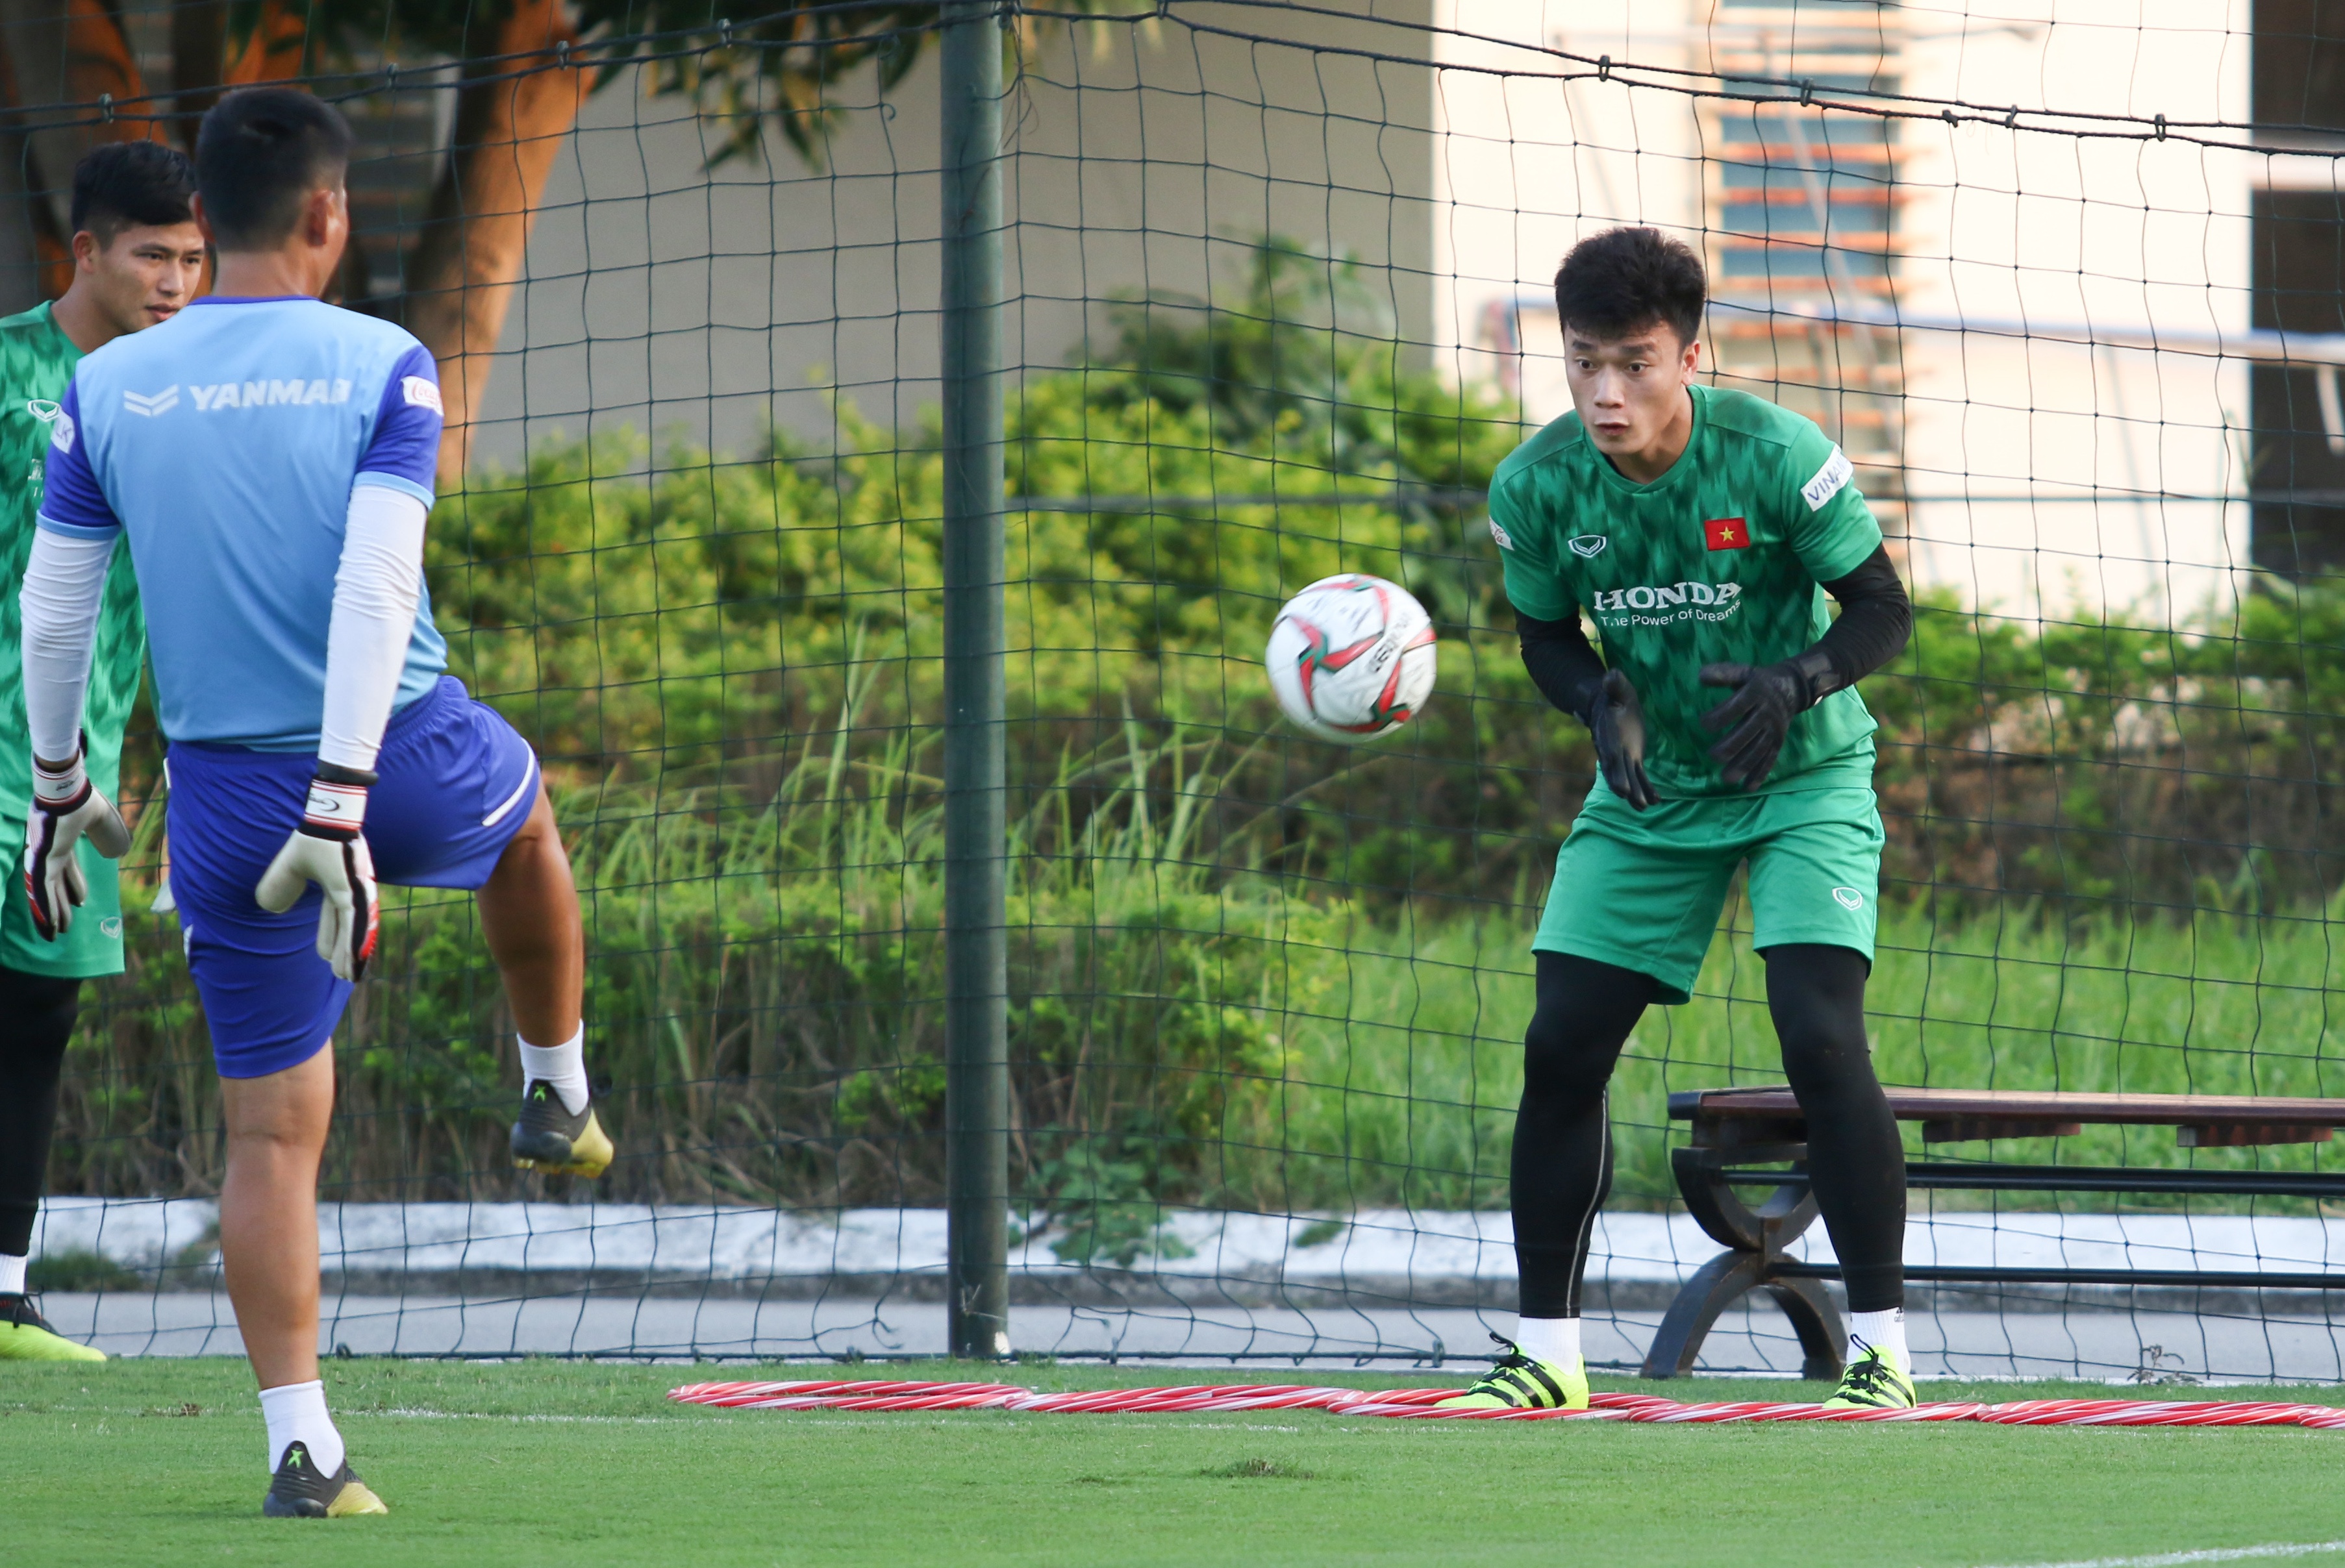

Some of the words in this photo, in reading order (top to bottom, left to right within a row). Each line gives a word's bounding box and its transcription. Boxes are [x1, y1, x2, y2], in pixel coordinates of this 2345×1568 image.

[1594, 581, 1743, 611] HONDA
[1631, 614, 1675, 626] Power
[1678, 608, 1693, 620] of
[1695, 599, 1741, 622] Dreams
